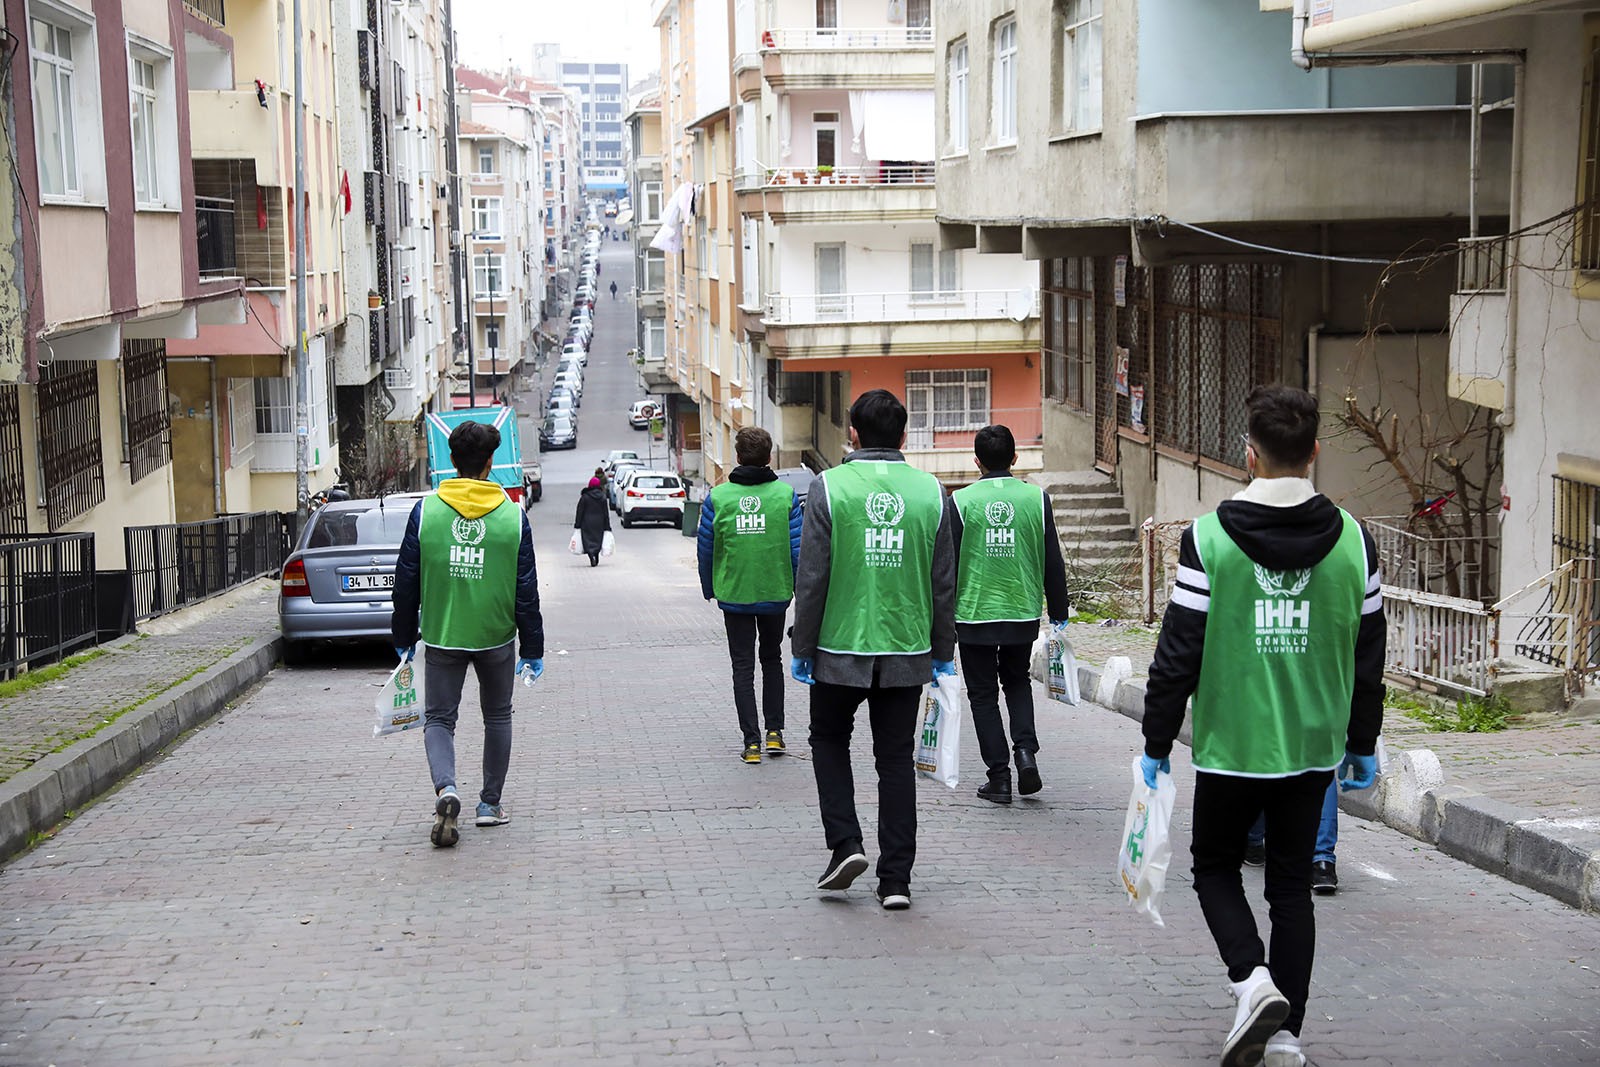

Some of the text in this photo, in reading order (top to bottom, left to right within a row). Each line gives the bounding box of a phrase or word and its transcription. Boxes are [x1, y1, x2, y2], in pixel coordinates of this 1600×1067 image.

[349, 575, 395, 588] 34 YL 38
